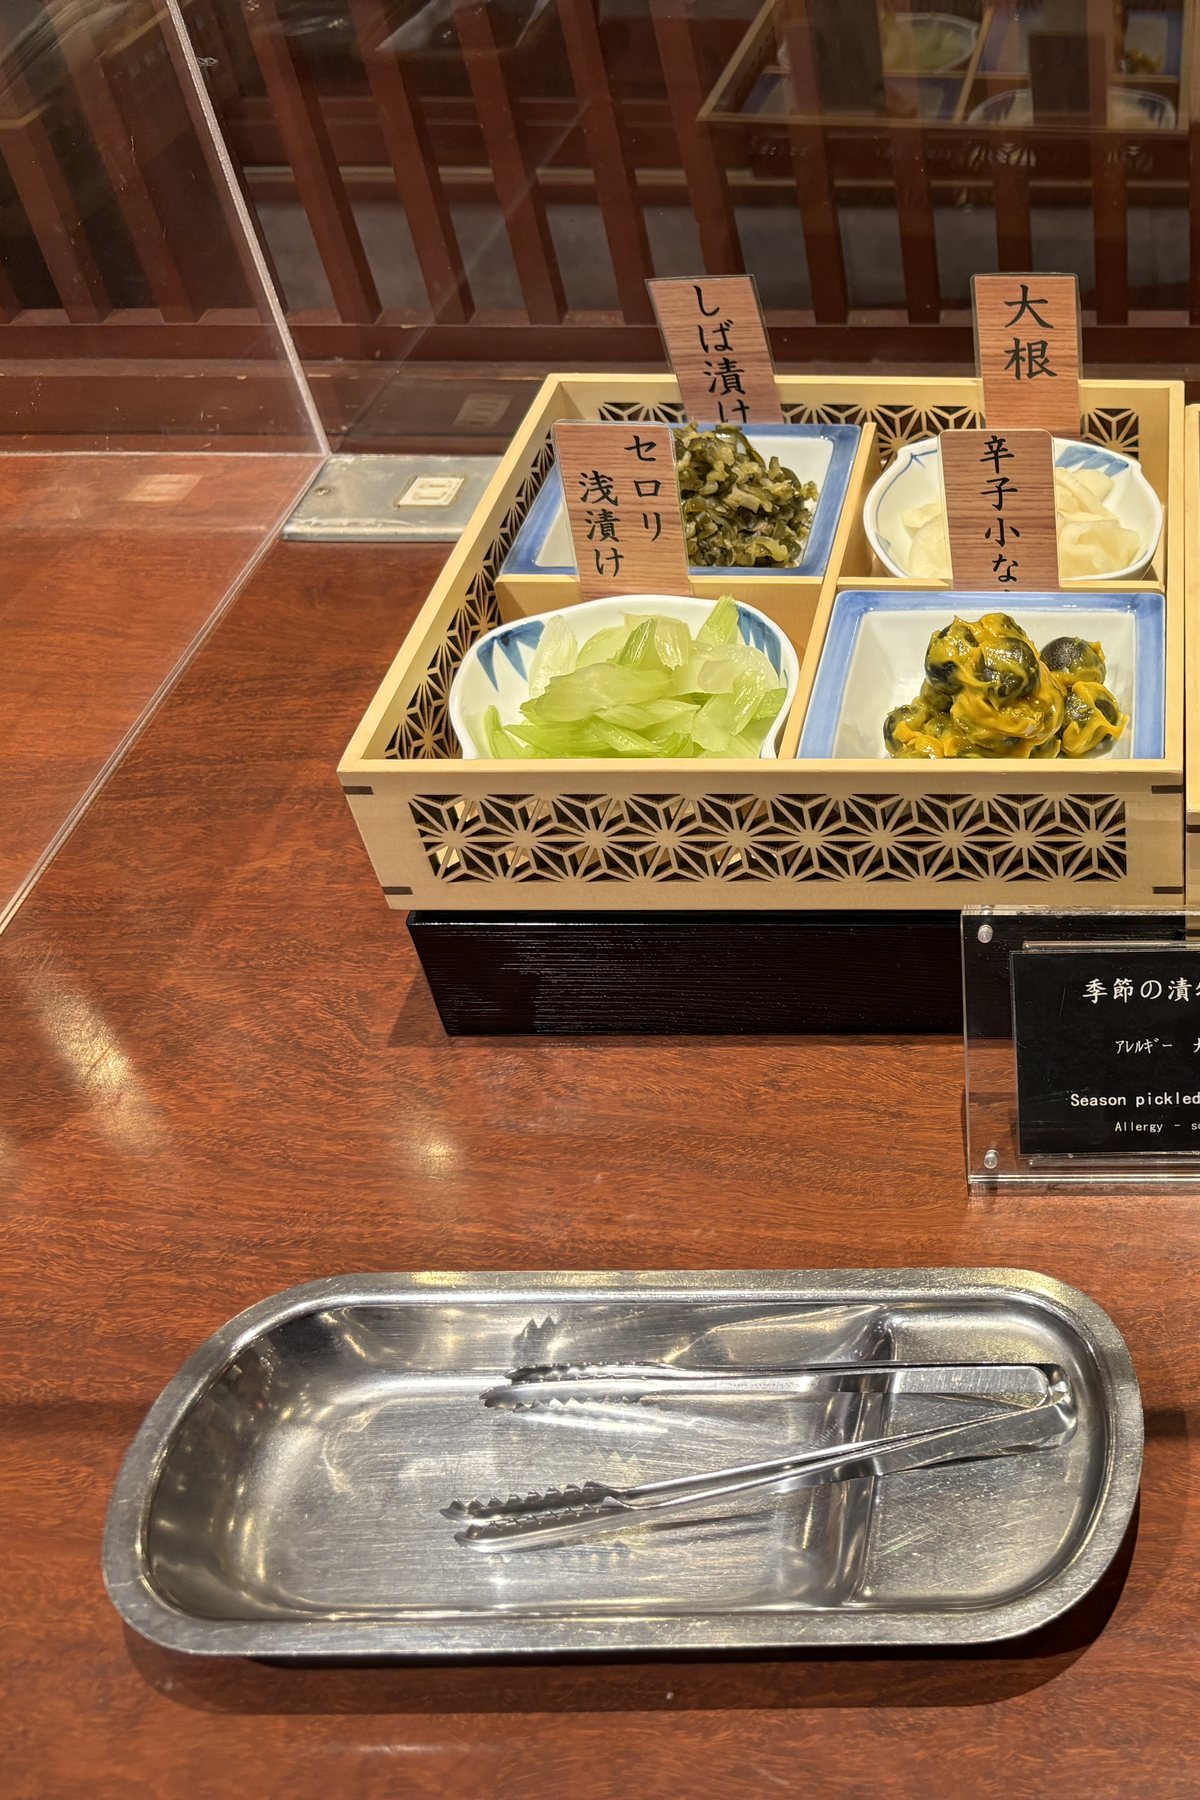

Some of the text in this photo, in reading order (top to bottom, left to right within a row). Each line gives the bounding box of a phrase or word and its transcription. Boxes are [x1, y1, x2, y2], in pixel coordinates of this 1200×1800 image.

[694, 285, 751, 424] しば漬け
[1003, 284, 1058, 381] 大根
[579, 471, 625, 578] 浅漬け
[624, 435, 666, 543] セロリ
[979, 435, 1021, 592] 辛子小な
[1070, 1093, 1127, 1107] Season
[1135, 1091, 1200, 1108] pickled
[1114, 1121, 1164, 1133] Allergy
